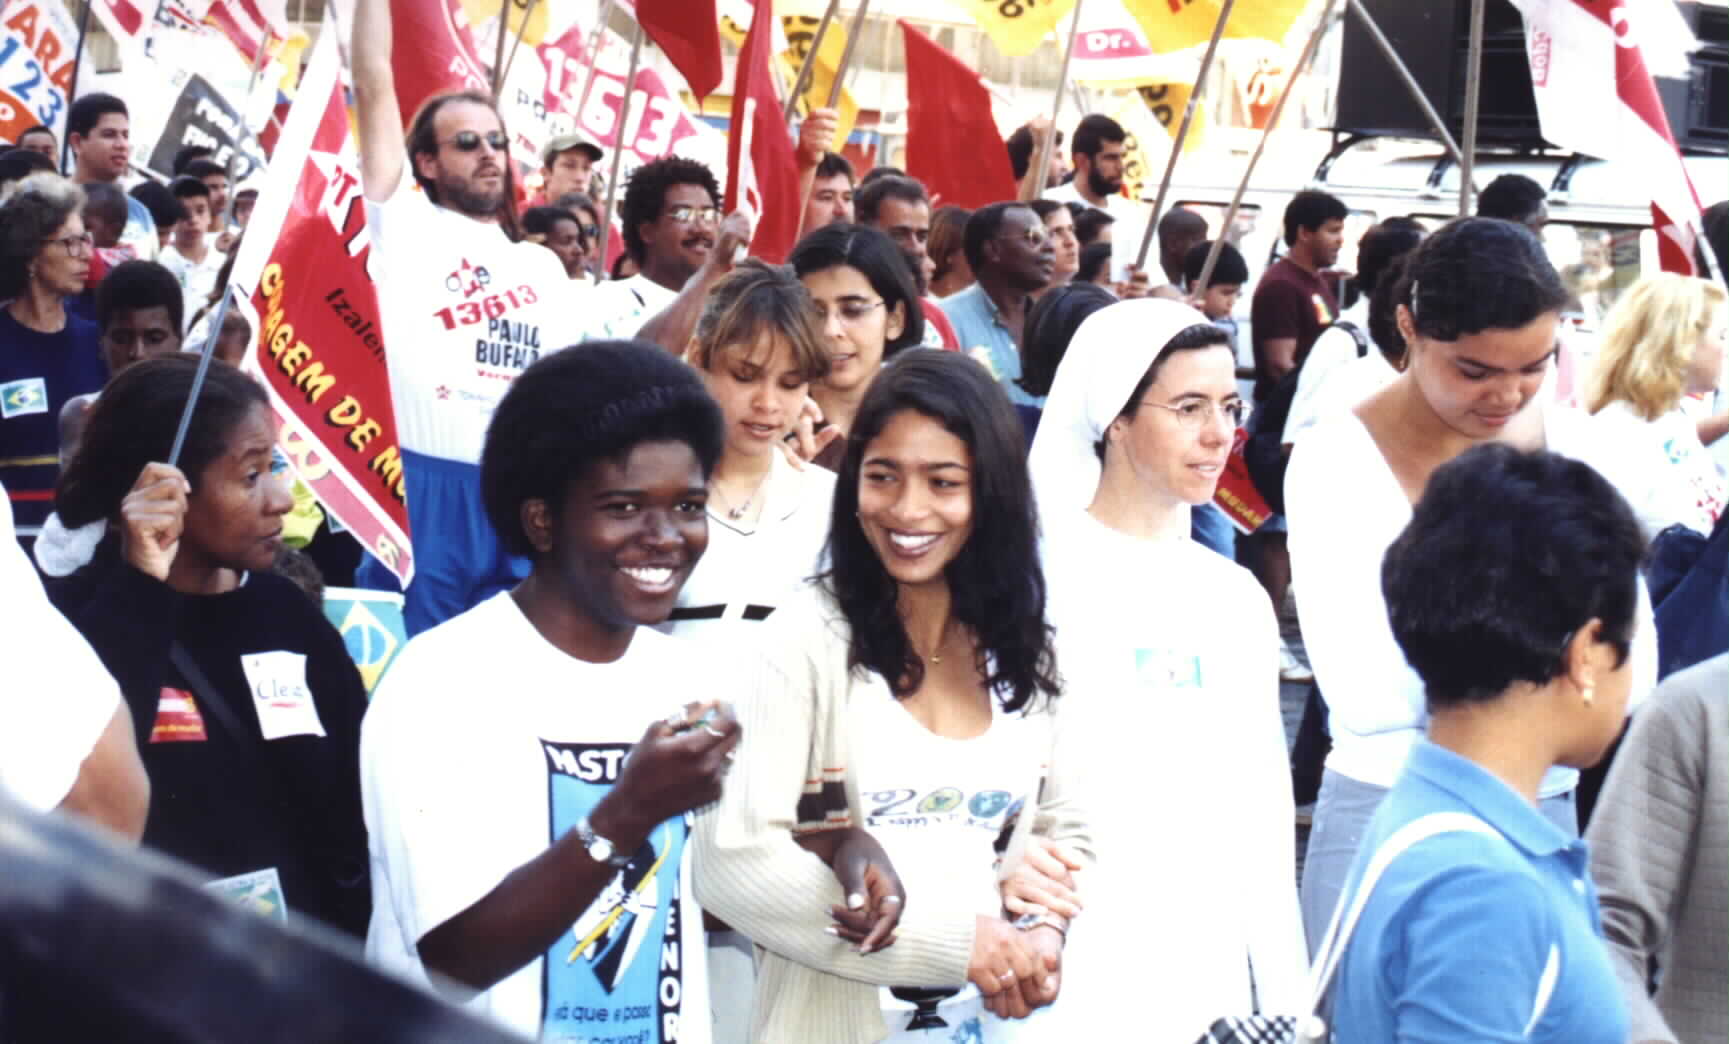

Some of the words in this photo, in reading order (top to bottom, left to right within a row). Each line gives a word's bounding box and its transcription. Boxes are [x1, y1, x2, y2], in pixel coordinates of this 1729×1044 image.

[1086, 32, 1131, 52] Dr.
[545, 46, 679, 158] 13613
[432, 284, 538, 331] 13613
[329, 396, 382, 453] DE
[572, 1005, 608, 1024] que
